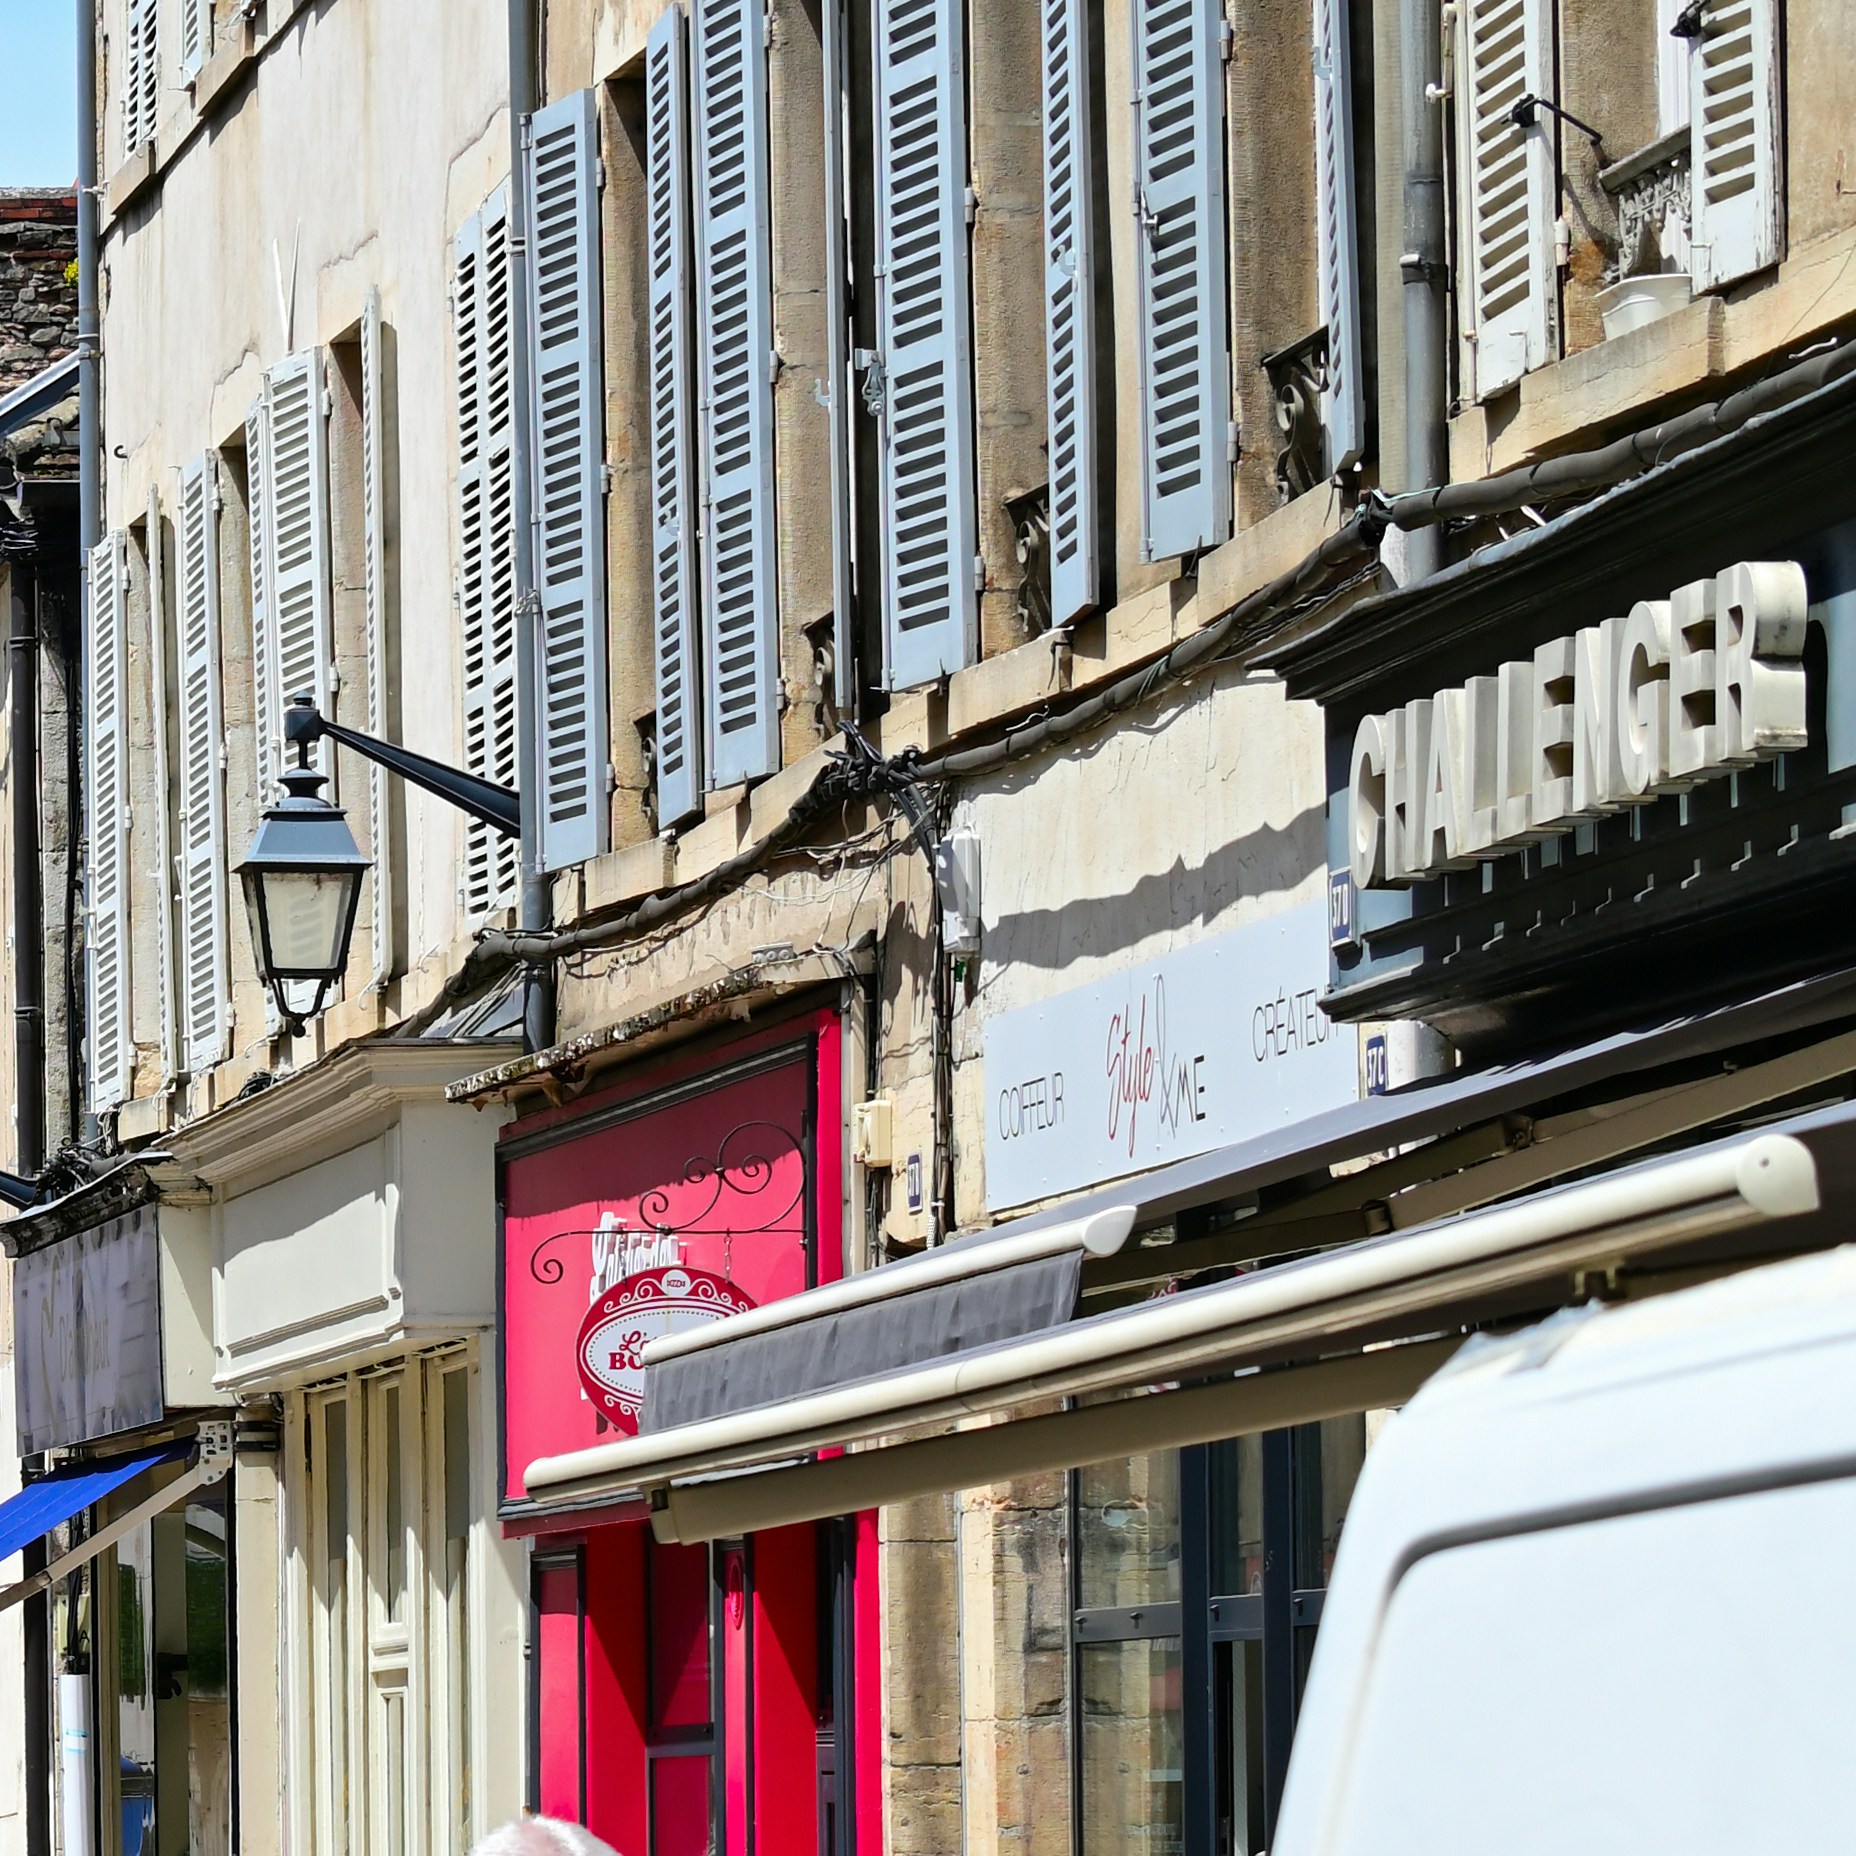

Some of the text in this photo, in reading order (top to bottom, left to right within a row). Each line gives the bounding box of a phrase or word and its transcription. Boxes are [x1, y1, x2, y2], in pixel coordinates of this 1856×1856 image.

[1348, 561, 1807, 890] CHALLENGER
[999, 1072, 1065, 1140] COIFFEUR
[1107, 994, 1154, 1158] Style
